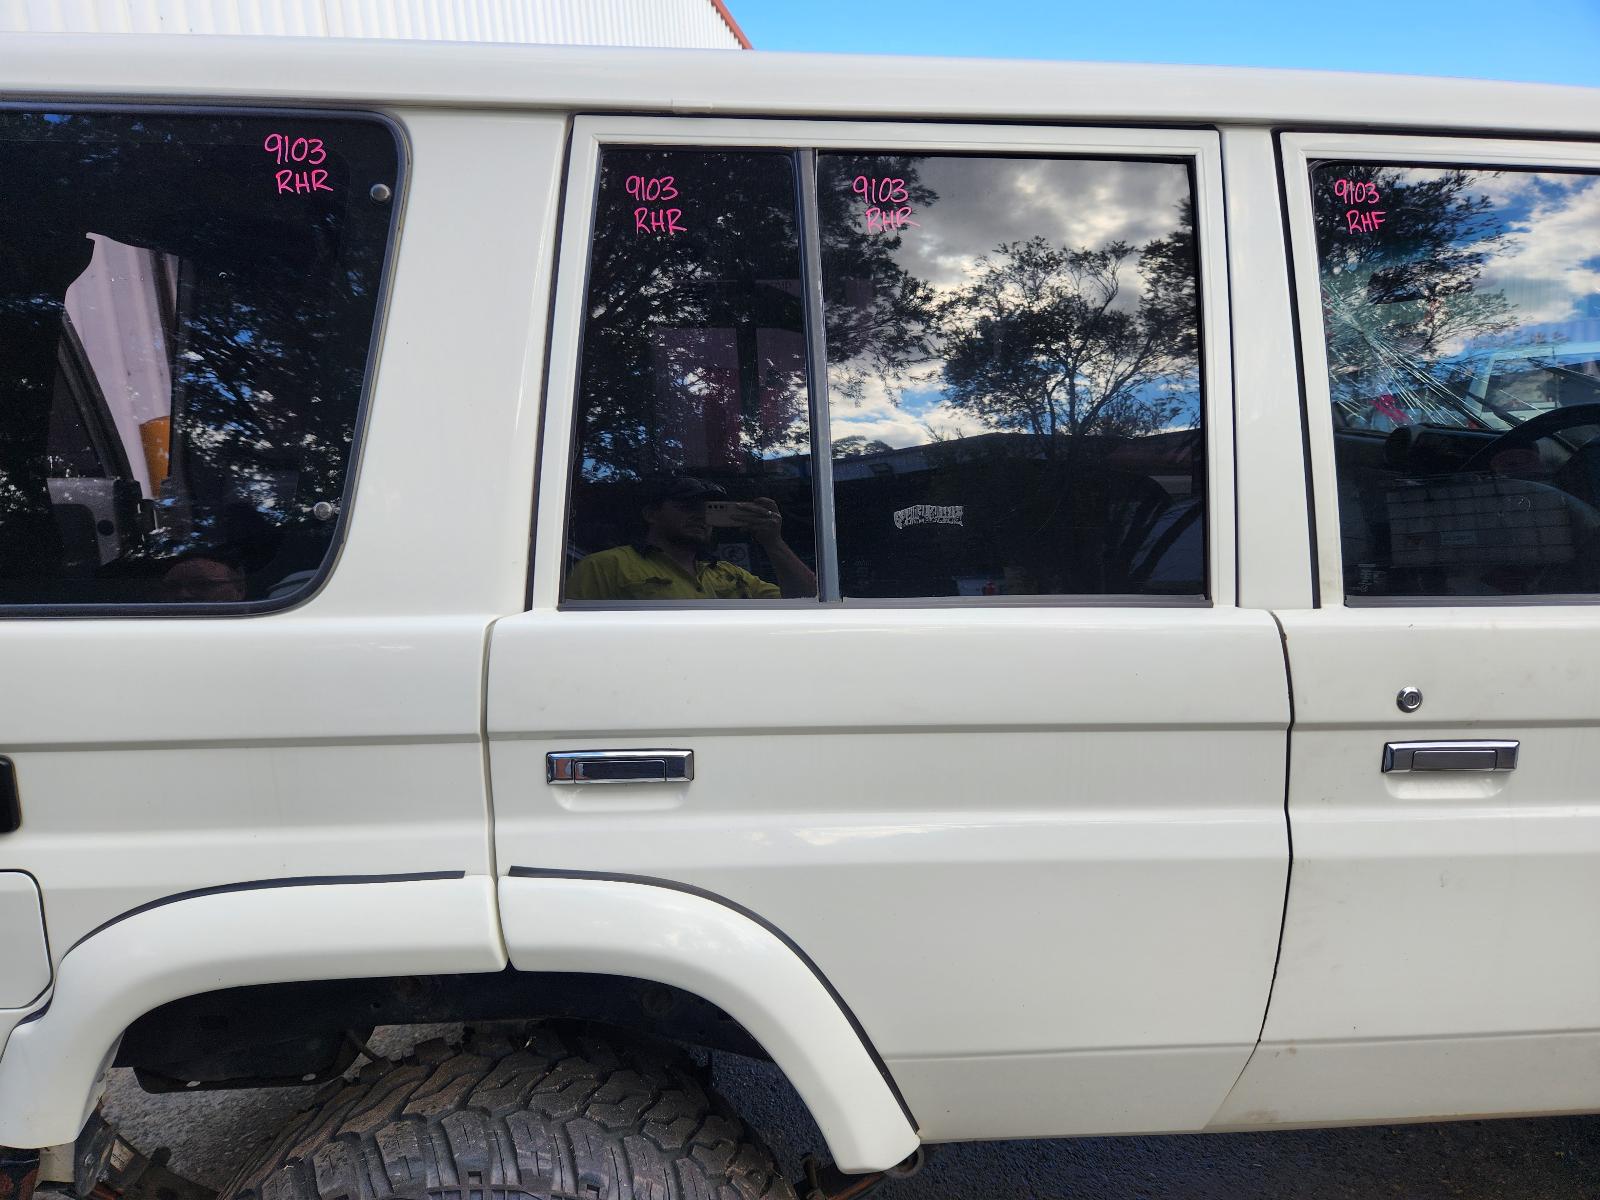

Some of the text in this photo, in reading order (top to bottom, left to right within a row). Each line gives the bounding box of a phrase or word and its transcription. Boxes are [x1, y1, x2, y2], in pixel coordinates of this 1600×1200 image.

[264, 133, 326, 165] 9103
[275, 169, 333, 194] RHR
[625, 175, 679, 201] 9103
[853, 176, 909, 204] 9103
[1334, 179, 1380, 205] 9103
[634, 207, 688, 234] RHR
[865, 207, 921, 234] RHR
[1346, 210, 1387, 235] RHF
